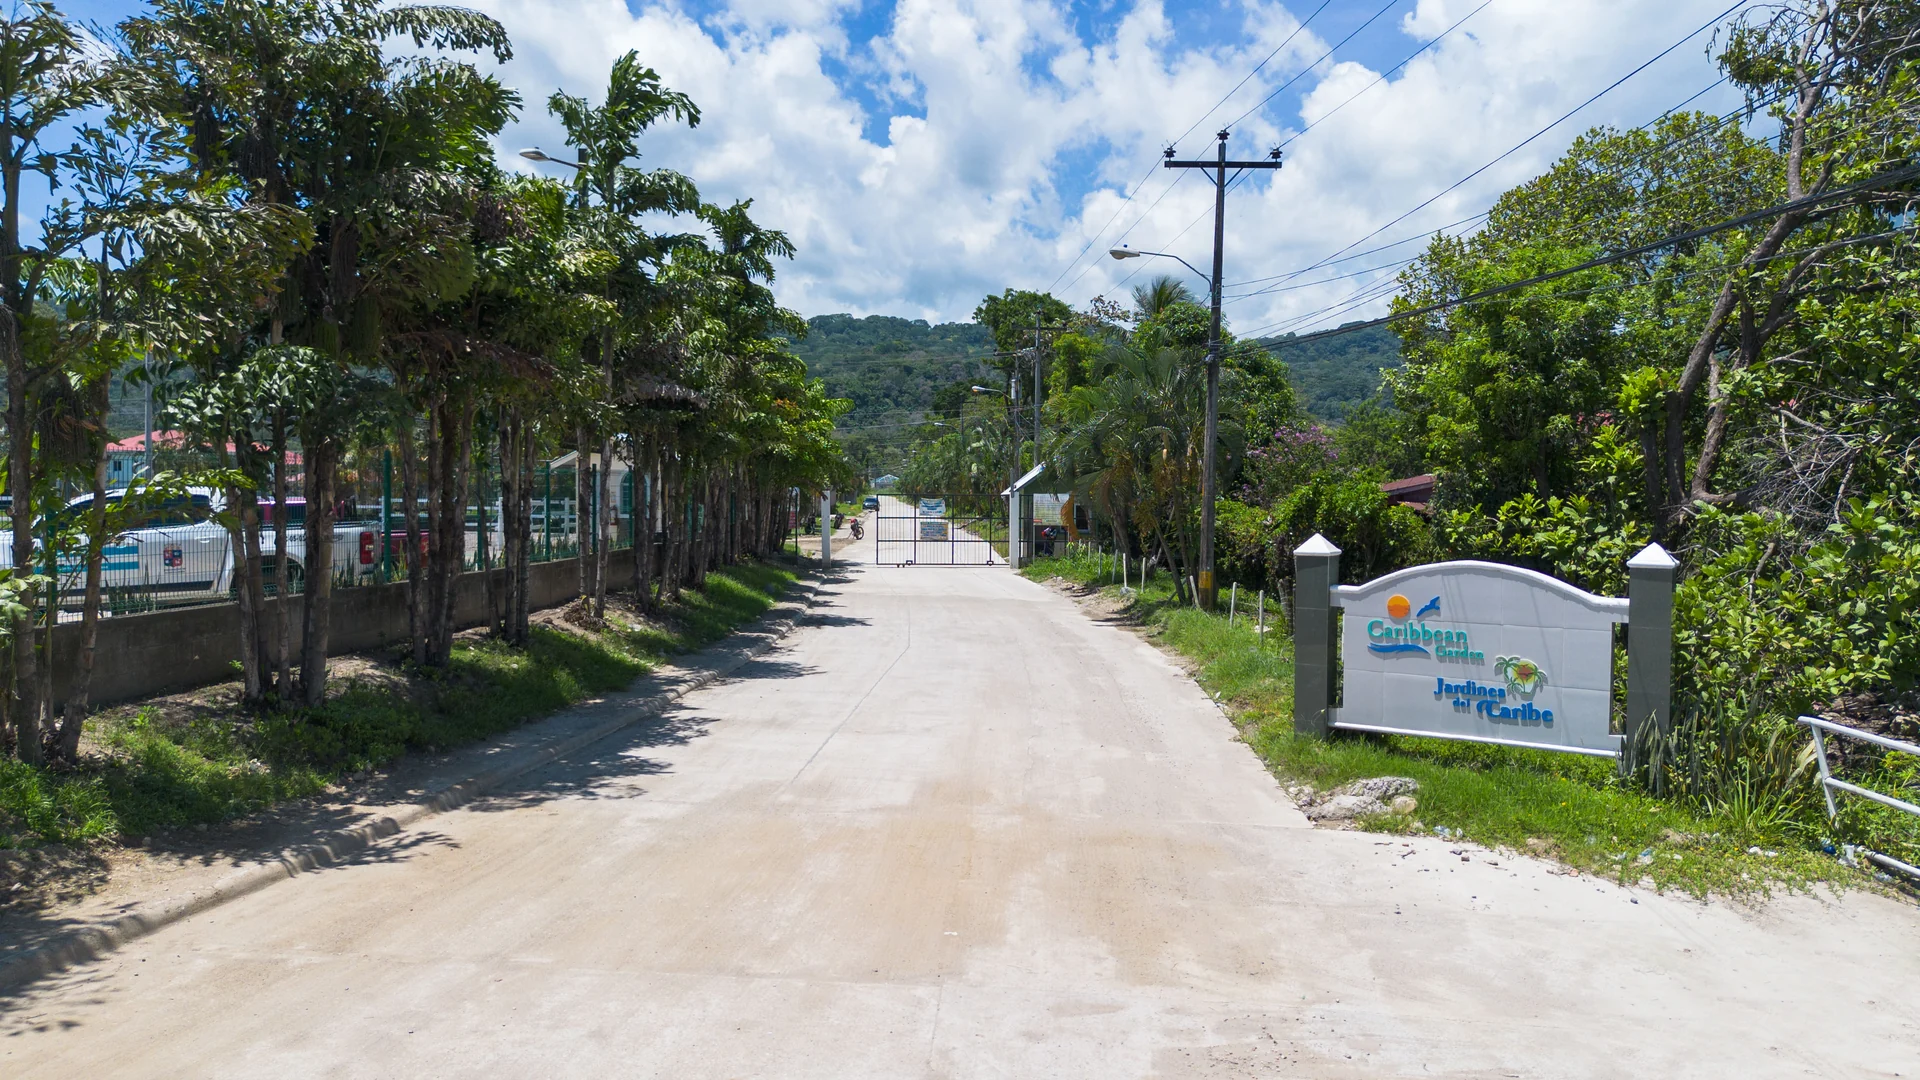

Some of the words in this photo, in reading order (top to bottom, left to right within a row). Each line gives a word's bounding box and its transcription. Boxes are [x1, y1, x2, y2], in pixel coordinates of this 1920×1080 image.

[1367, 619, 1468, 643] Caribbean
[1435, 645, 1485, 660] Garden
[1433, 677, 1506, 698] Jardines
[1452, 697, 1471, 708] del
[1476, 699, 1554, 723] Caribe
